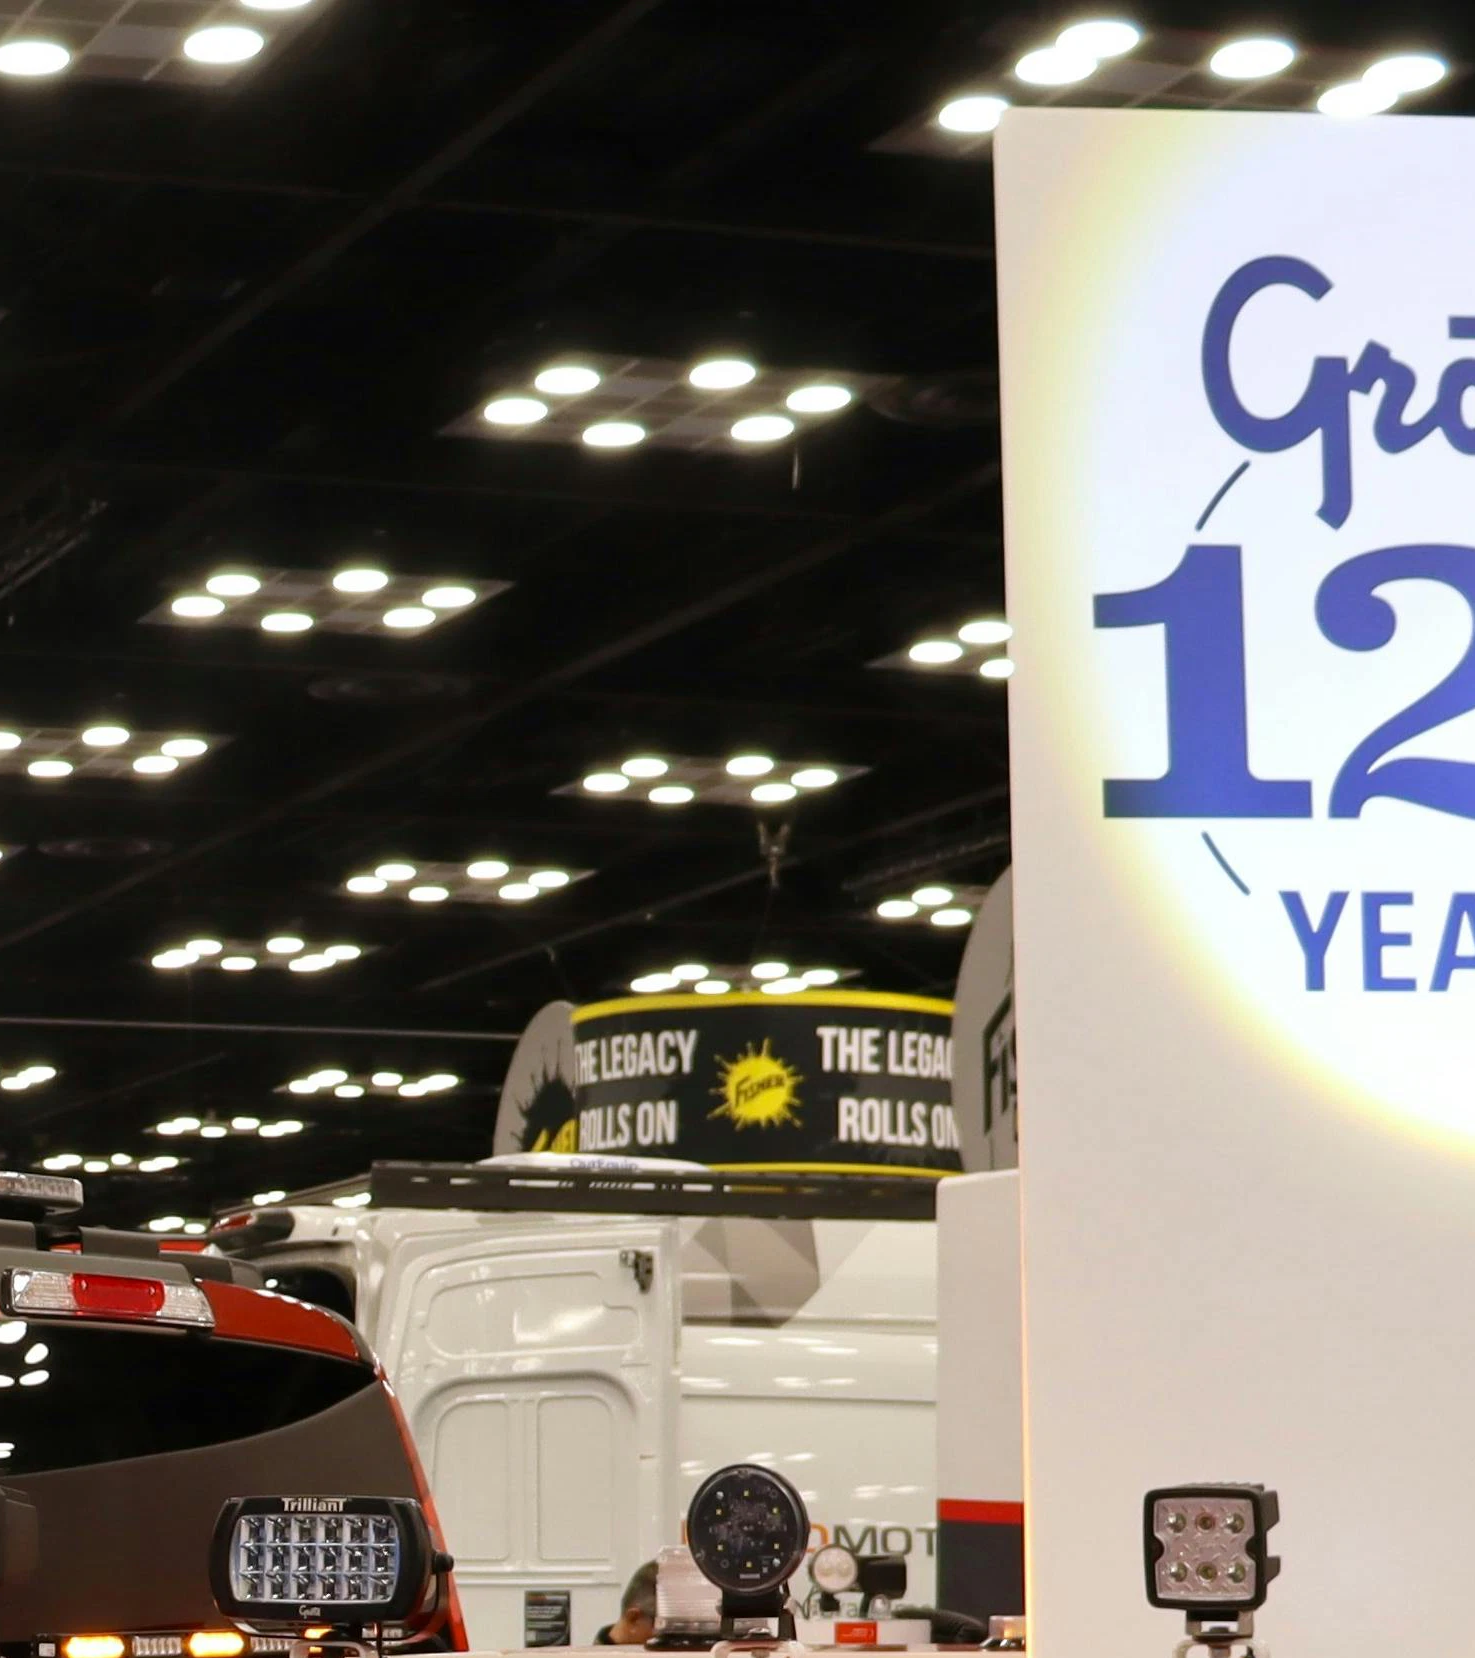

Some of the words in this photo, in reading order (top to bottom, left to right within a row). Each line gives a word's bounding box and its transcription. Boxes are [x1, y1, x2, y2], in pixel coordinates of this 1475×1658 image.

[601, 1029, 699, 1081] LEGACY
[816, 1025, 882, 1073] THE
[578, 1102, 632, 1152] ROLLS
[635, 1099, 679, 1147] ON
[837, 1097, 928, 1147] ROLLS
